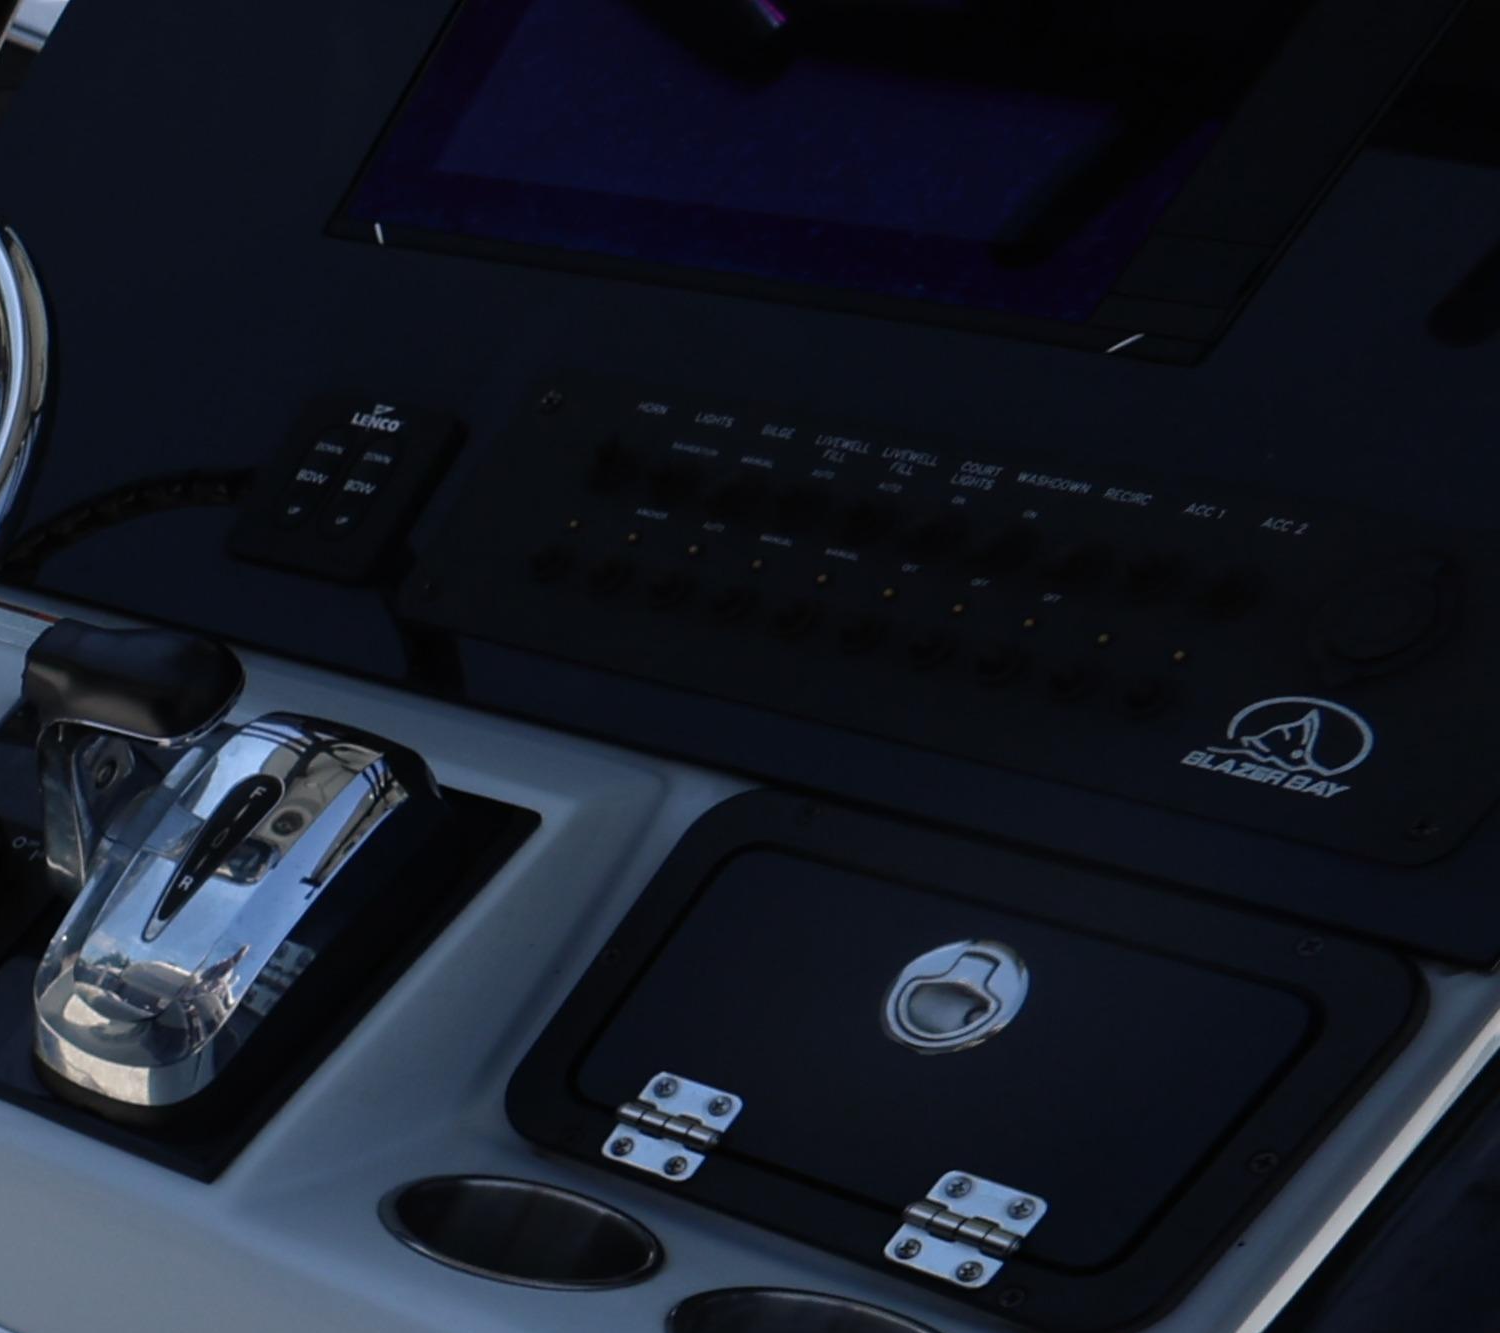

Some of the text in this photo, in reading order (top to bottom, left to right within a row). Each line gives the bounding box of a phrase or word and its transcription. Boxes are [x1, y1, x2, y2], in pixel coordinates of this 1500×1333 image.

[351, 412, 402, 433] LENCO
[694, 411, 736, 429] LIGHTS
[761, 423, 797, 441] BILGE
[814, 433, 871, 457] LIVEWELL
[821, 448, 846, 465] FILL
[881, 446, 940, 470] LIVEWELL
[296, 468, 328, 485] BOW
[888, 461, 915, 478] FILL
[959, 459, 1005, 478] COURT
[343, 479, 376, 495] BOW
[950, 472, 996, 492] LIGHTS
[1017, 471, 1092, 496] WASHDOWN
[1102, 485, 1154, 507] RECIRC
[1182, 501, 1214, 519] ACC
[1259, 515, 1311, 536] ACC 2
[1180, 750, 1351, 798] BLAZER BAY
[249, 786, 267, 799] F
[178, 875, 194, 891] R
